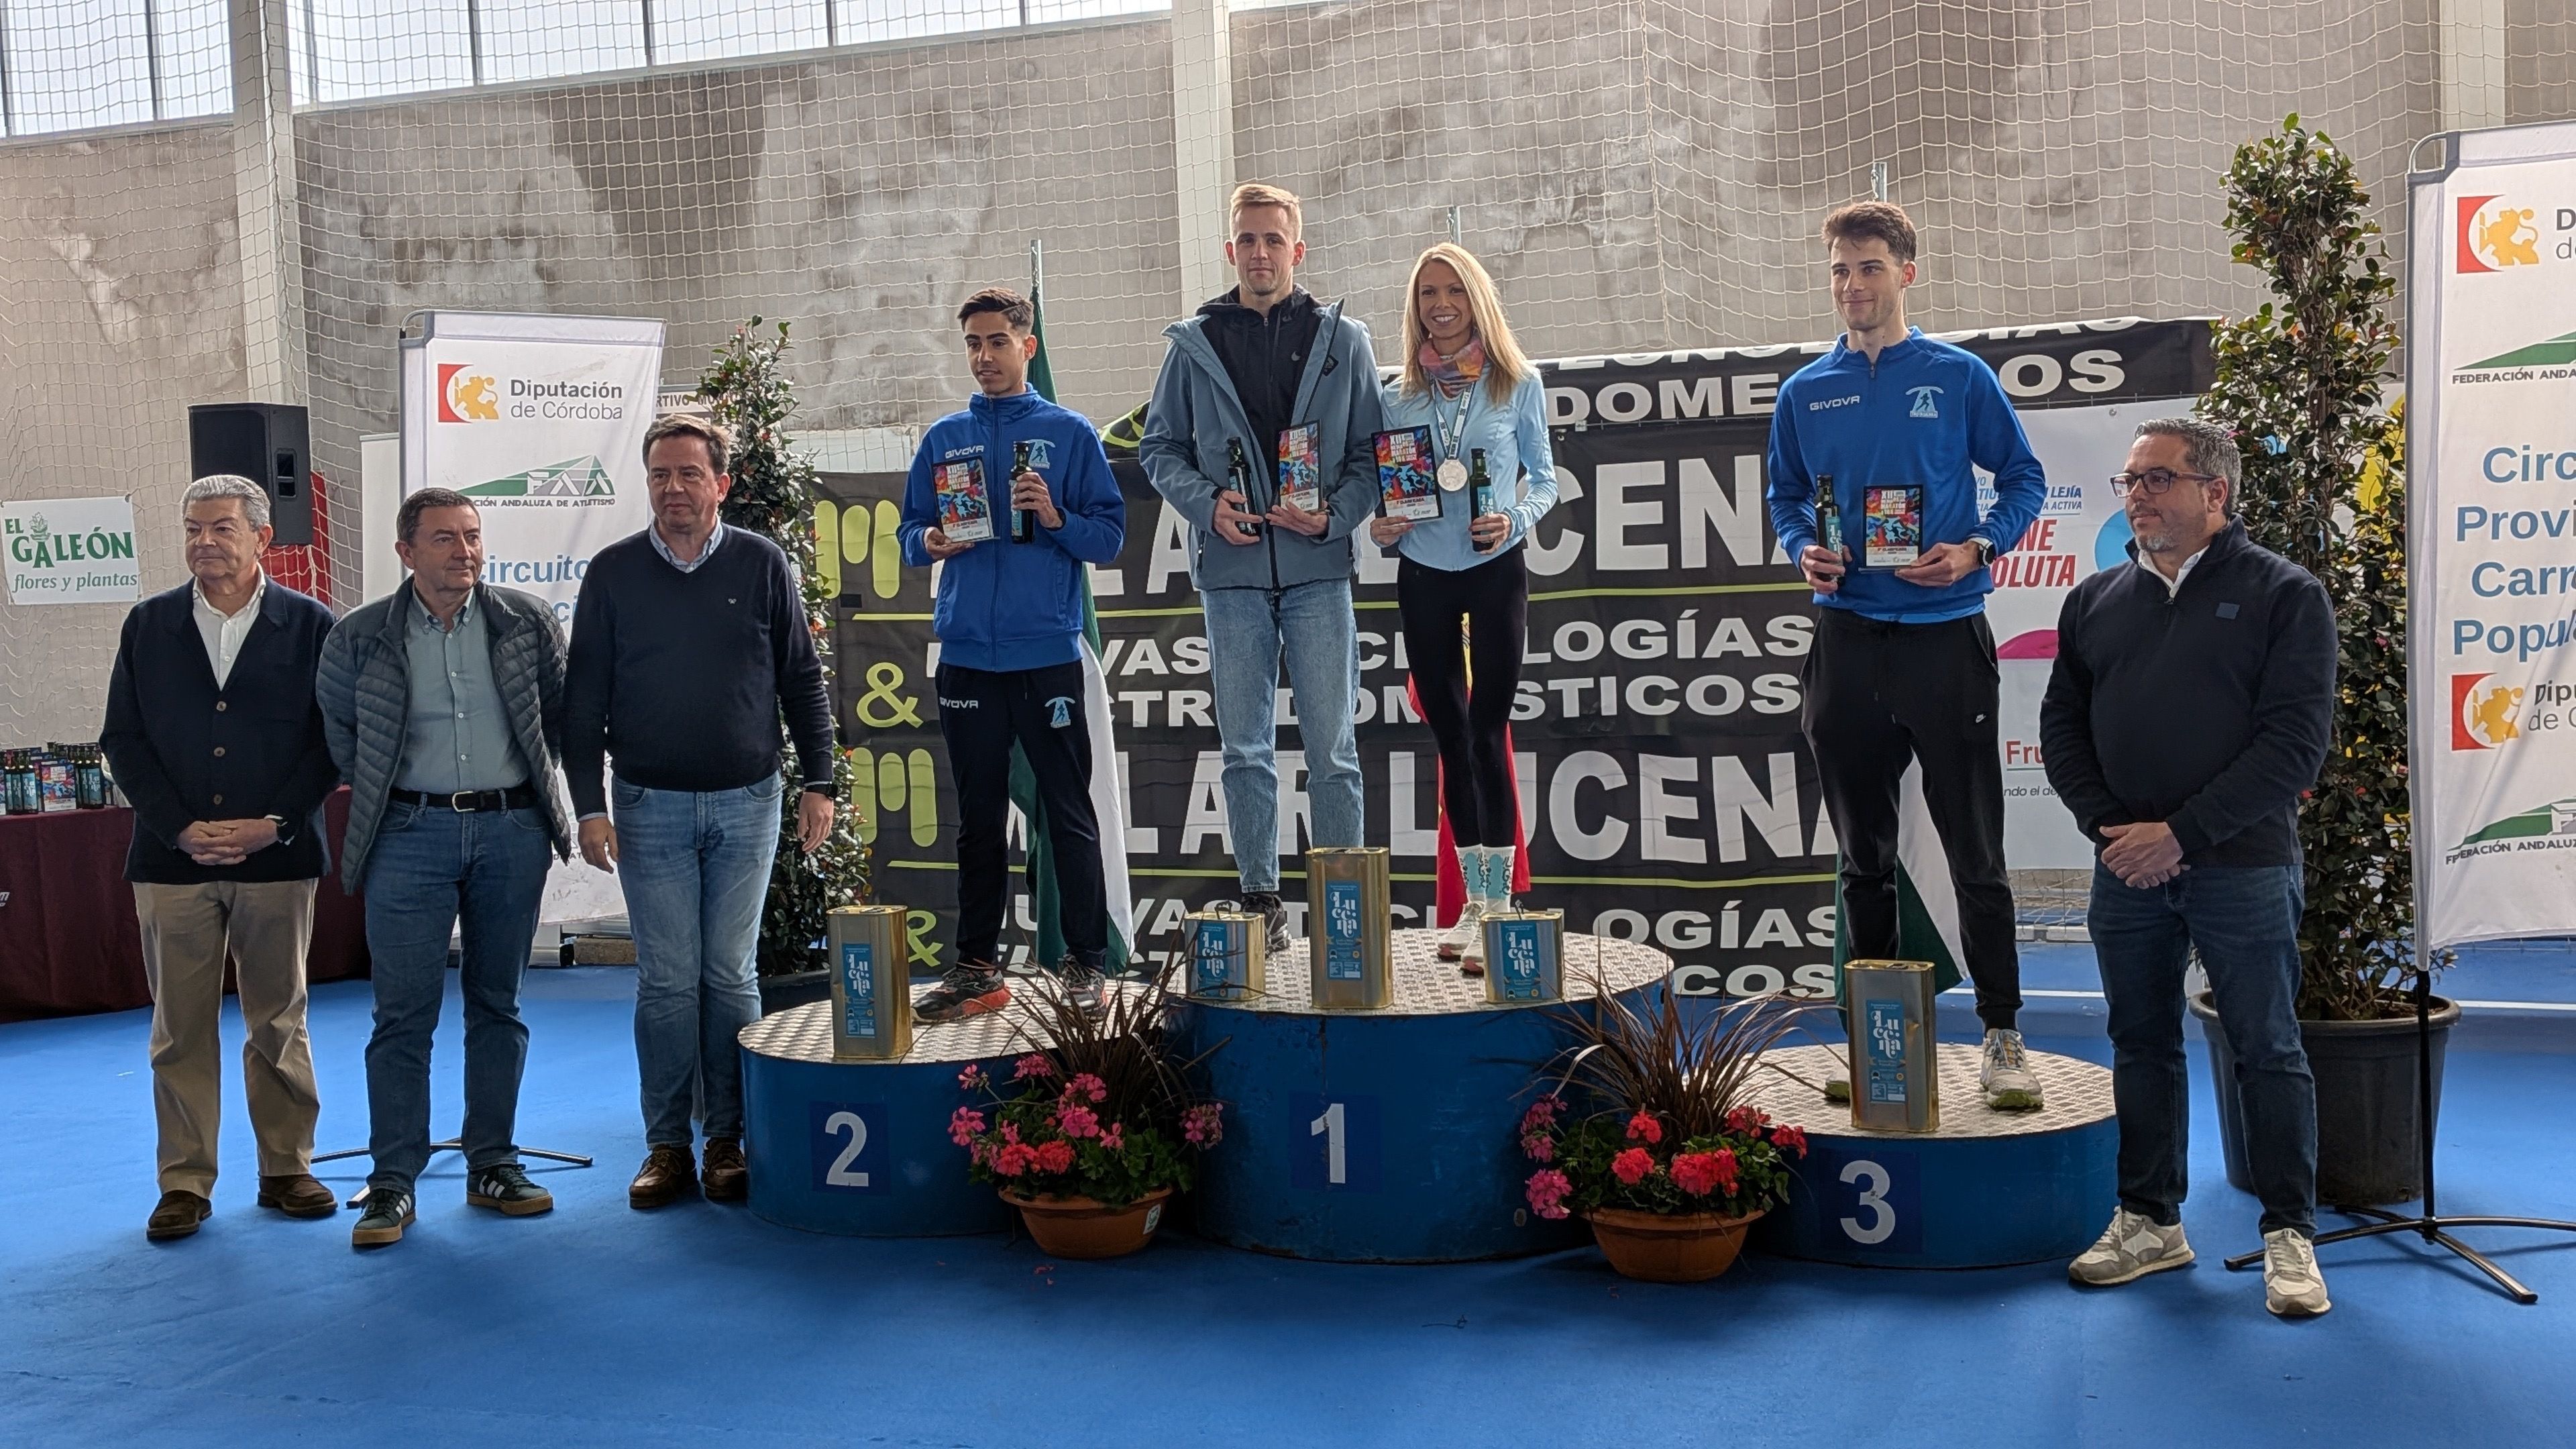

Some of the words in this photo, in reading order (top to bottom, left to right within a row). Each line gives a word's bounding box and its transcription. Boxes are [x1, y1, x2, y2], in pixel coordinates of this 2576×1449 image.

[2452, 367, 2534, 384] FEDERACIÓN
[2539, 369, 2576, 380] ANDA
[510, 378, 623, 401] Diputación
[510, 401, 536, 418] de
[542, 400, 623, 420] Córdoba
[1809, 394, 1861, 412] GIVOVA
[945, 445, 985, 459] GIVOVA
[2050, 485, 2082, 498] LEJÍA
[500, 498, 552, 507] ANDALUZA
[556, 499, 569, 507] DE
[2051, 500, 2082, 511] ACTIVA
[5, 518, 24, 535] EL
[11, 526, 135, 569] GALEÓN
[12, 574, 57, 593] flores
[61, 576, 71, 592] y
[76, 572, 138, 591] plantas
[856, 661, 924, 729] &
[2528, 708, 2559, 731] de
[2030, 786, 2040, 796] el
[824, 1111, 869, 1187] 2
[1311, 1103, 1346, 1184] 1
[1839, 1160, 1896, 1244] 3
